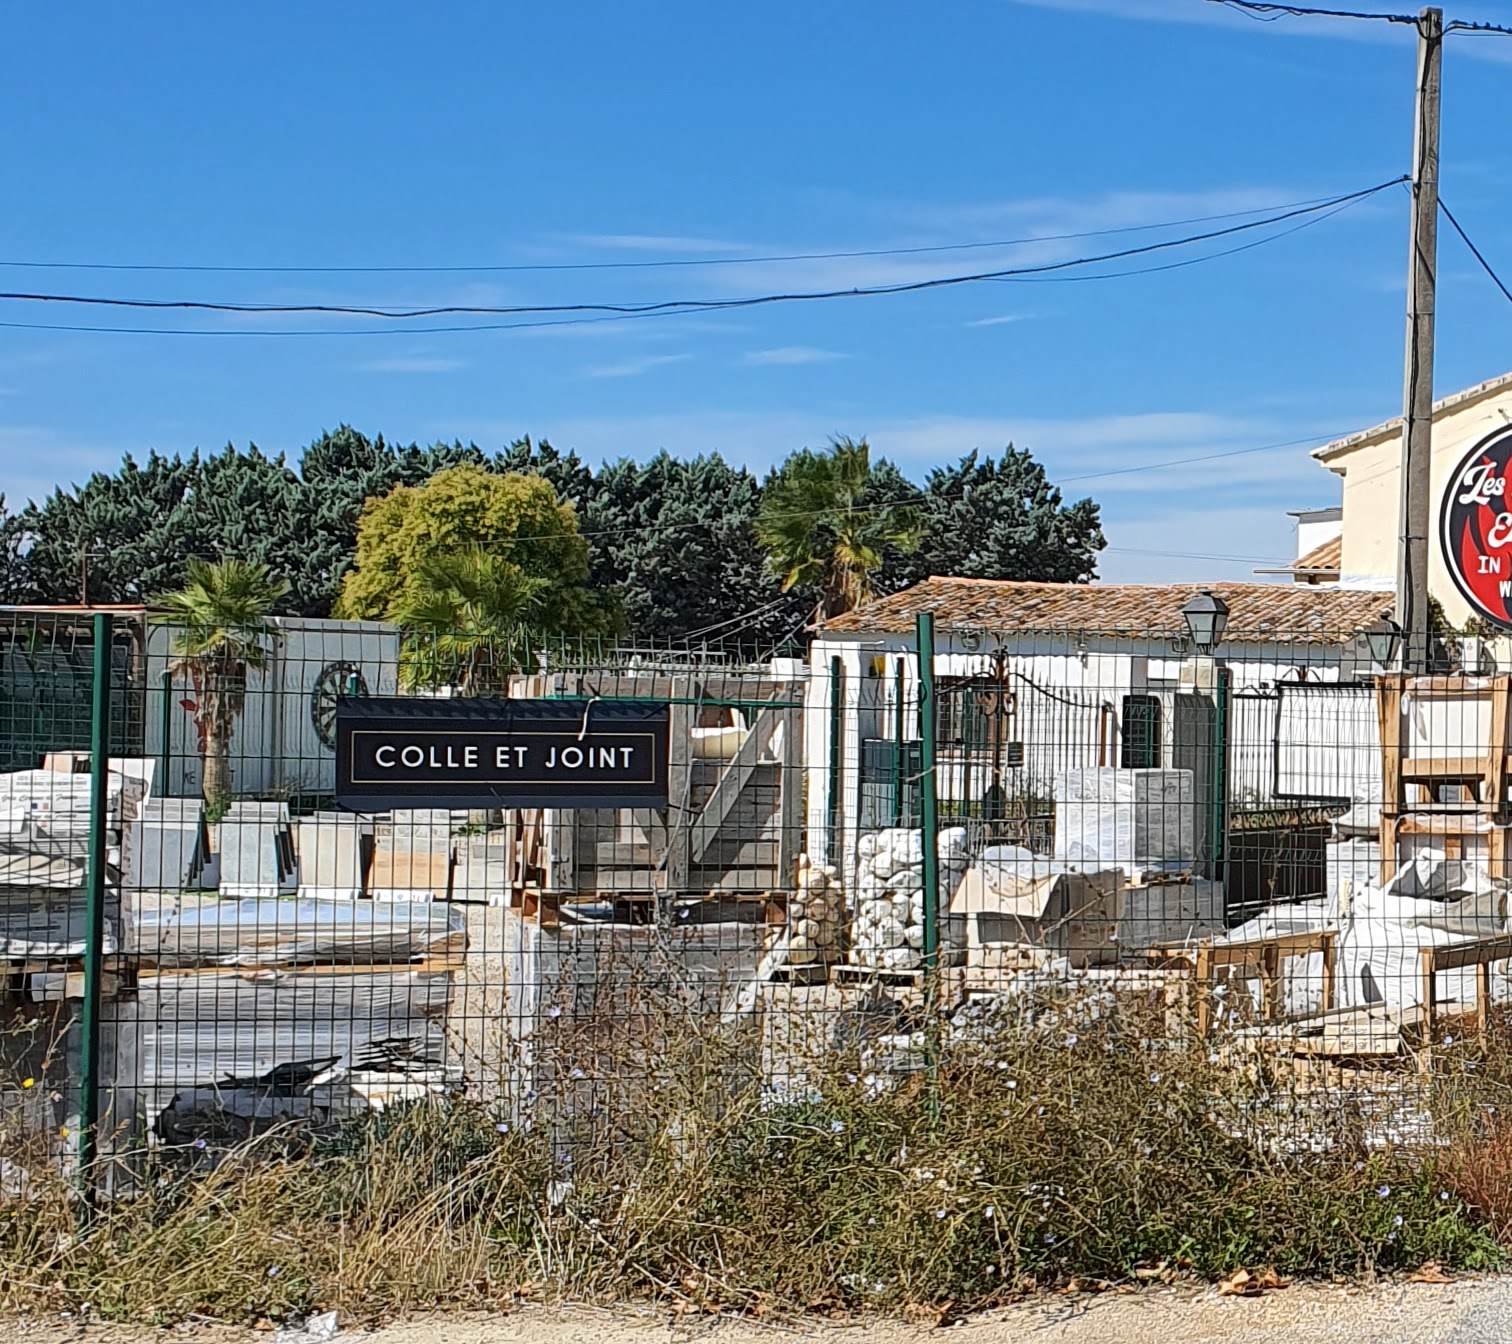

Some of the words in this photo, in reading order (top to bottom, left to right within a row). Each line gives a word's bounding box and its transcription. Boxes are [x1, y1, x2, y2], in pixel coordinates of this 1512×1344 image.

[1459, 462, 1505, 505] Les
[1477, 556, 1500, 574] IN
[375, 746, 478, 768] COLLE
[496, 746, 528, 768] ET
[545, 747, 634, 769] JOINT
